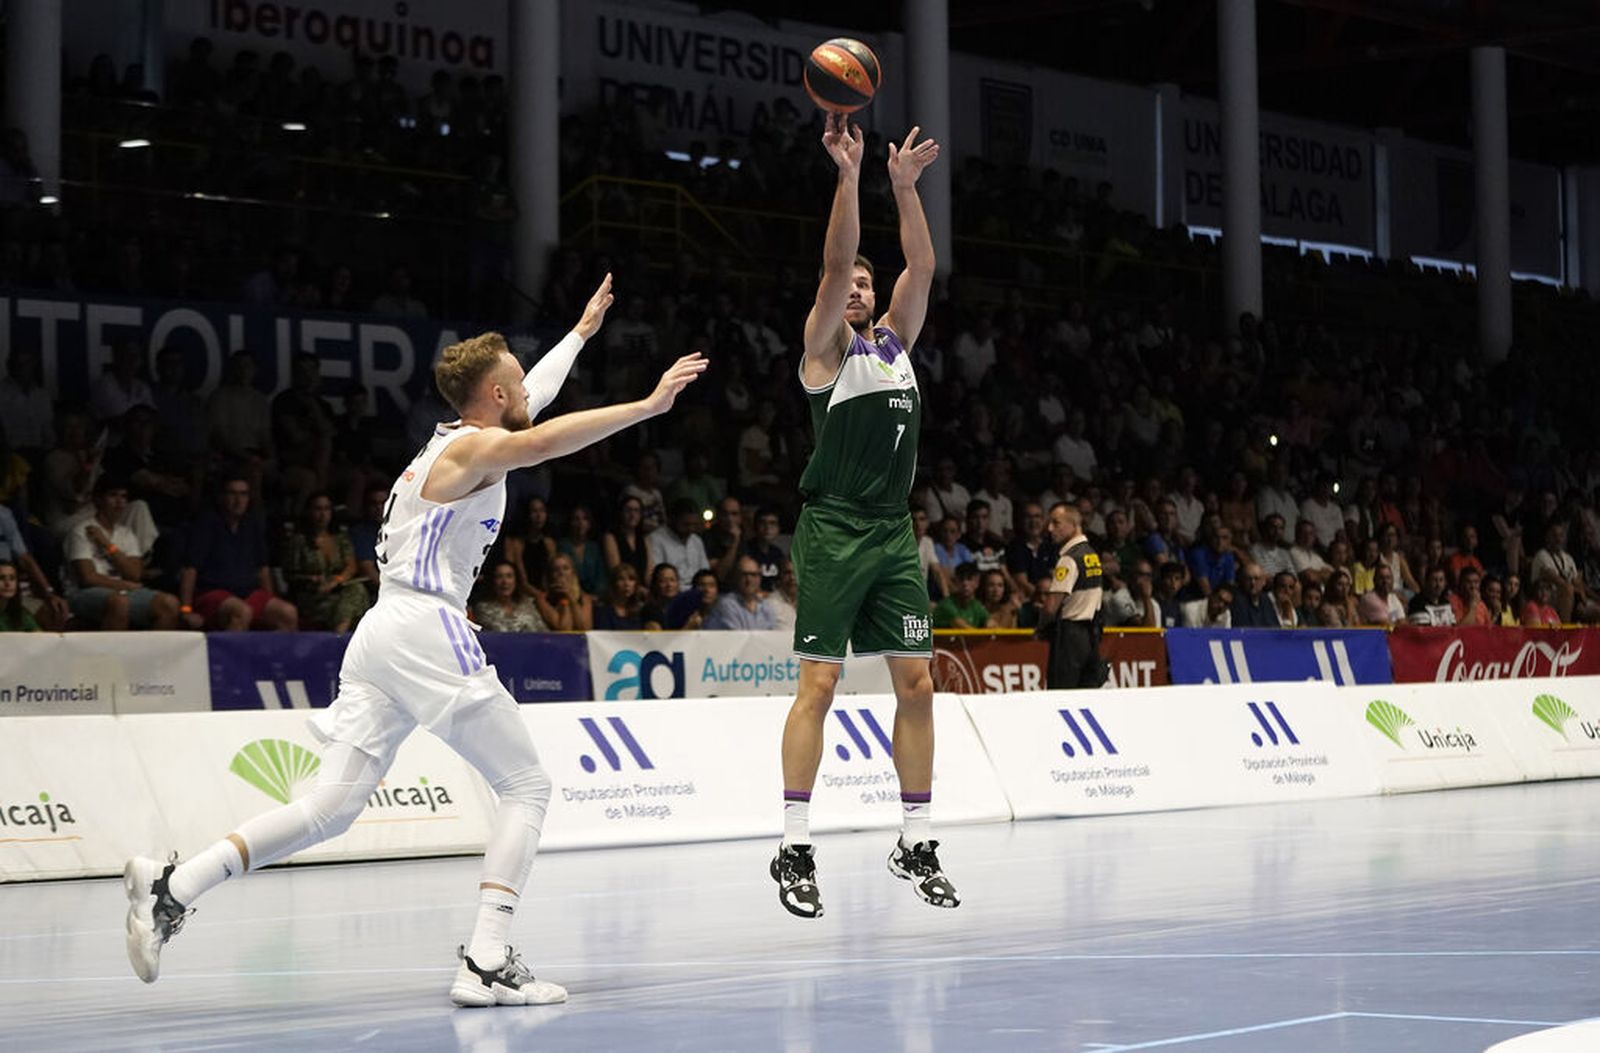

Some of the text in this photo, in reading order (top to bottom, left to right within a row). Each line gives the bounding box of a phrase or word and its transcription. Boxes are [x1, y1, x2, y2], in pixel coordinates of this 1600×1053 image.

[599, 16, 804, 86] UNIVERSID
[894, 423, 906, 453] 7
[16, 684, 98, 703] Provincial
[1418, 726, 1477, 752] Unicaja
